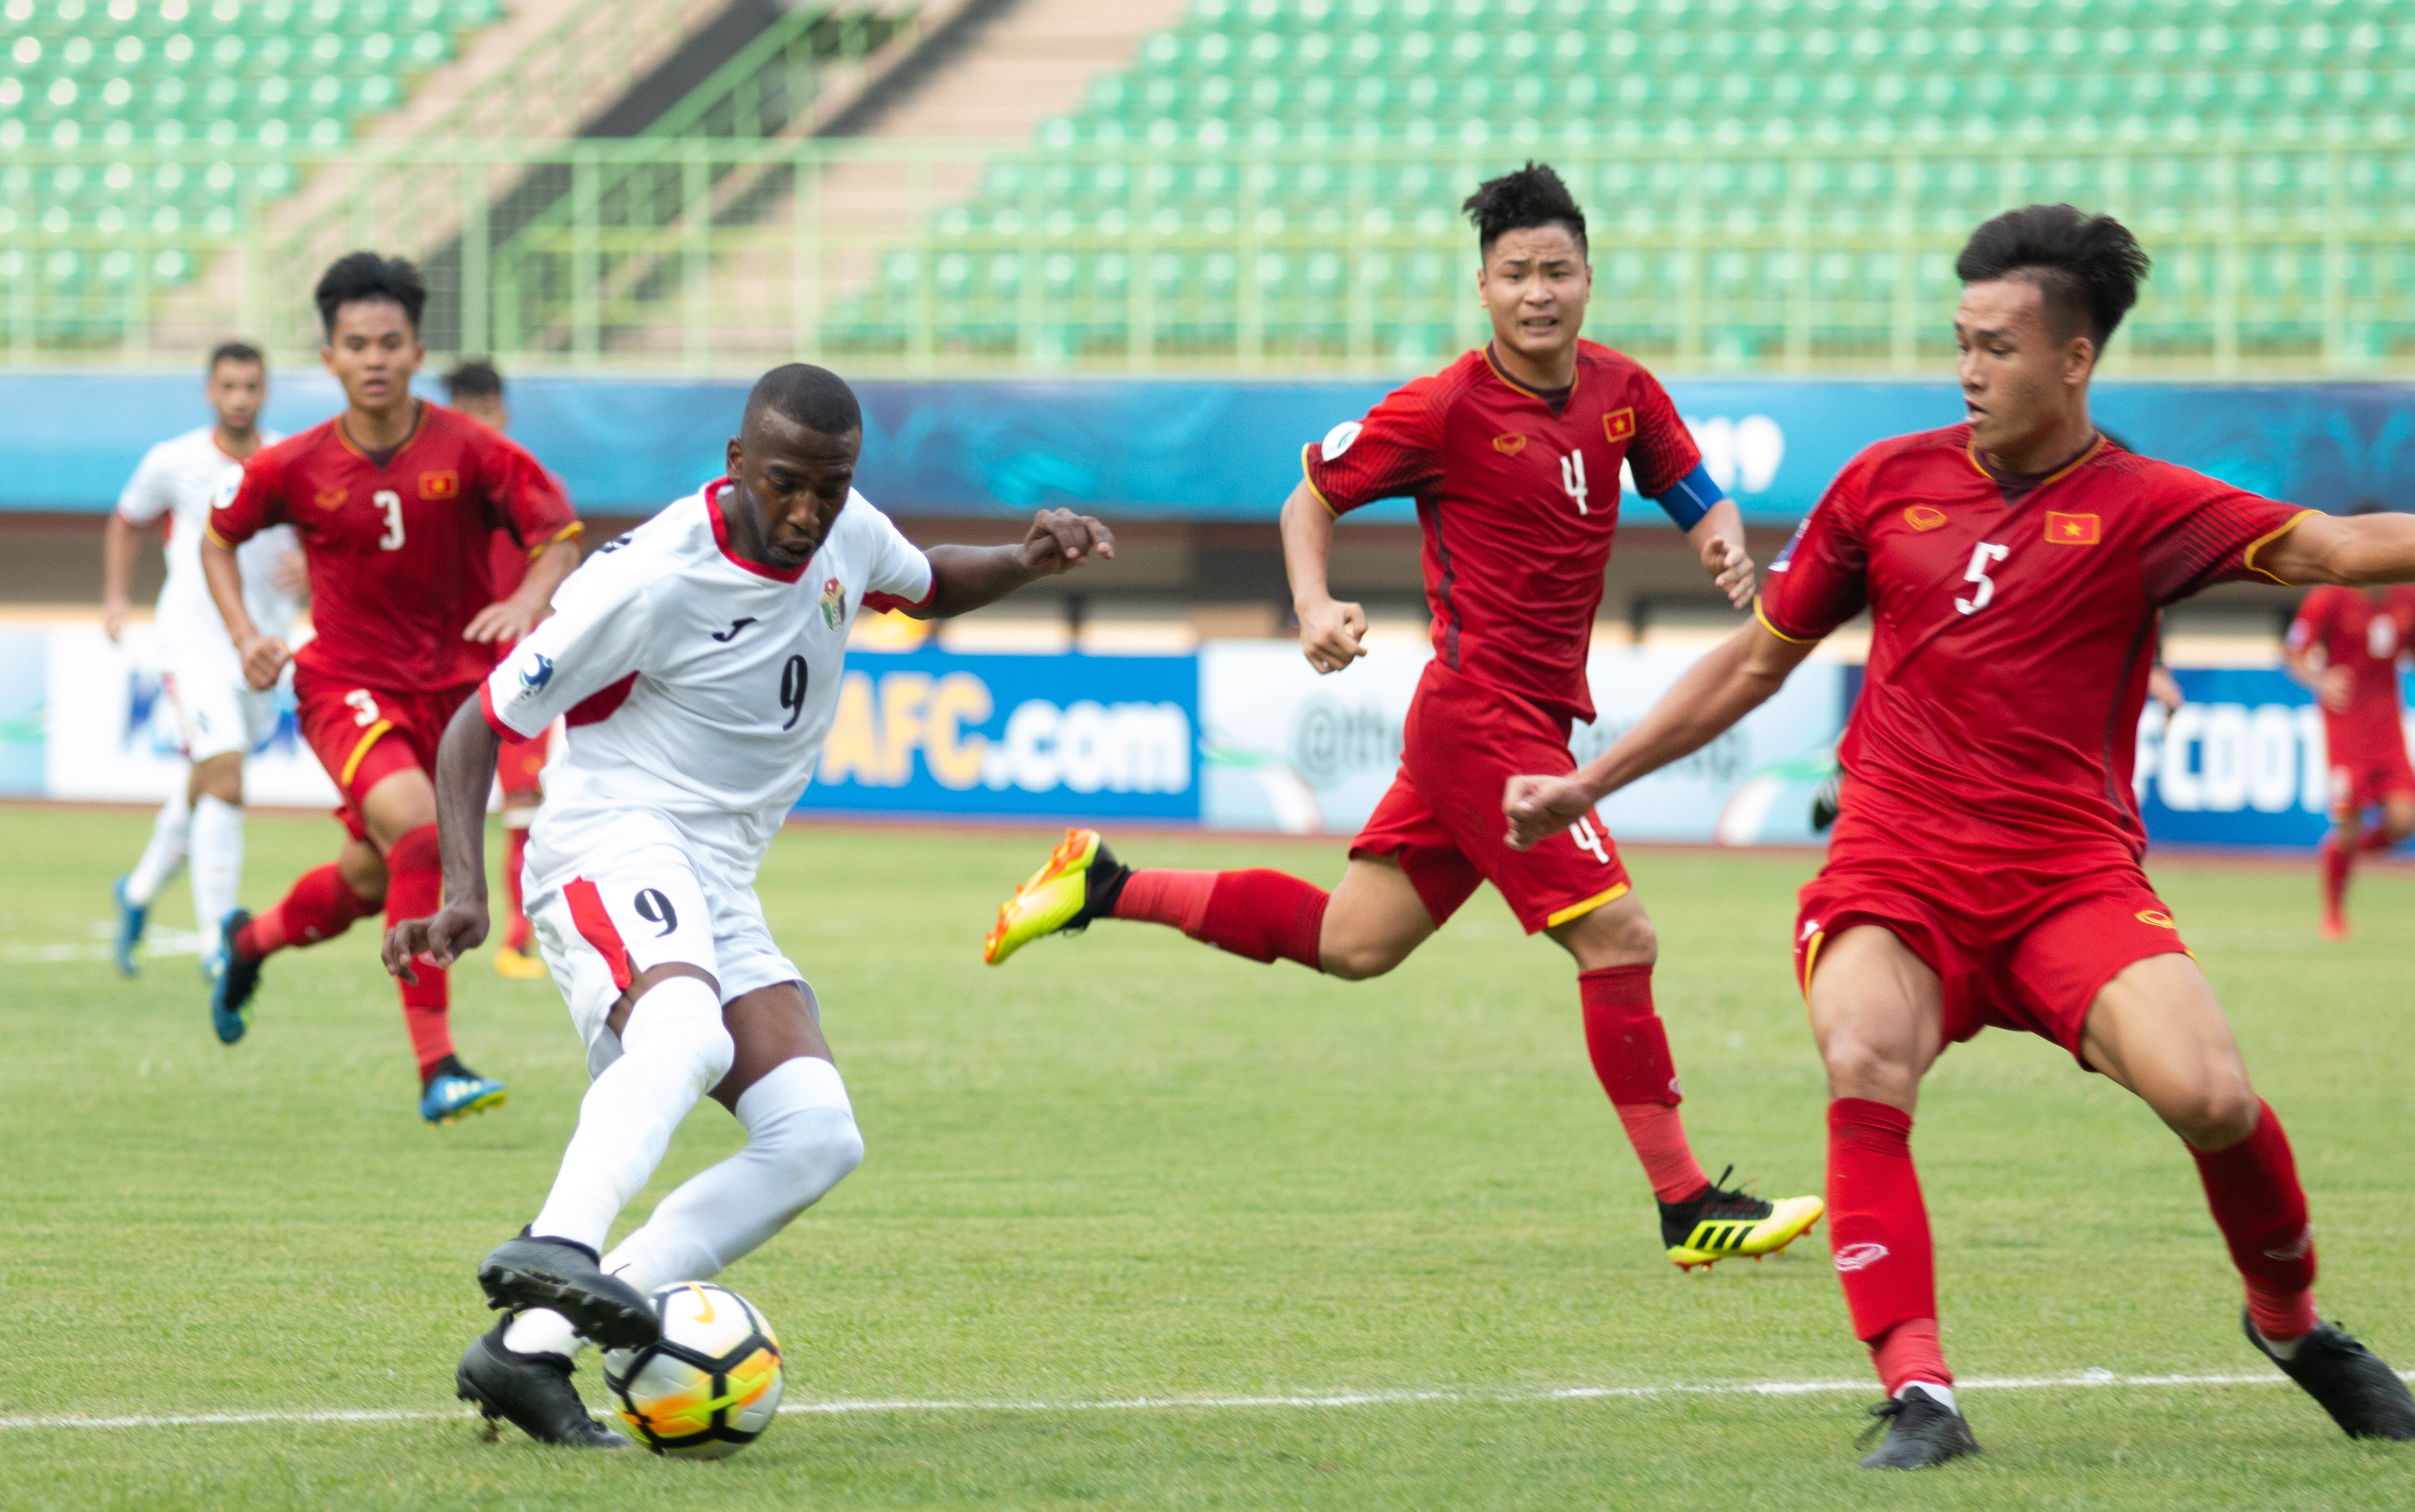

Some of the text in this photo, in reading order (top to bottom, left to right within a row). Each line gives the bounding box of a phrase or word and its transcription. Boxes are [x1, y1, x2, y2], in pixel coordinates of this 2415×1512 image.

[1560, 448, 1589, 515] 4
[373, 491, 406, 551] 3
[1955, 541, 2009, 615] 5
[347, 689, 380, 727] 3
[780, 654, 808, 732] 9
[1568, 816, 1610, 864] 4
[634, 888, 678, 939] 9
